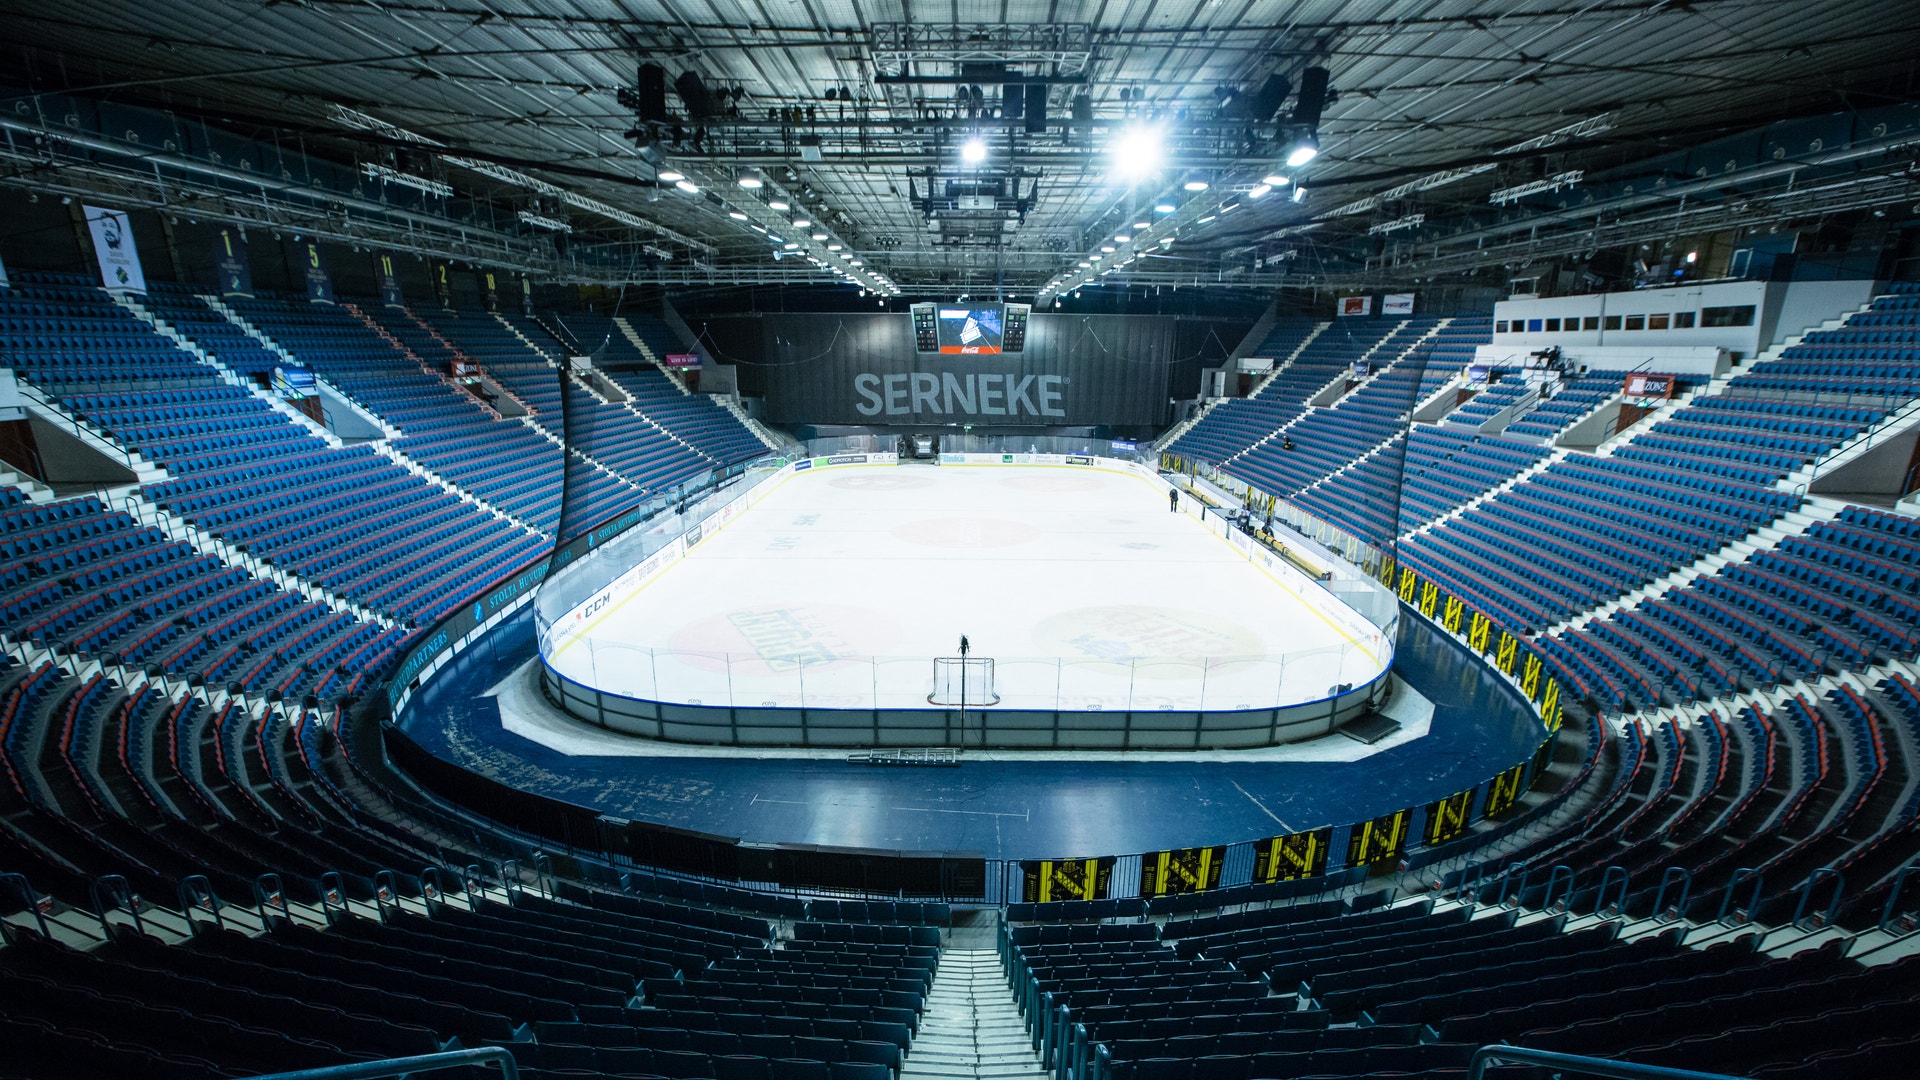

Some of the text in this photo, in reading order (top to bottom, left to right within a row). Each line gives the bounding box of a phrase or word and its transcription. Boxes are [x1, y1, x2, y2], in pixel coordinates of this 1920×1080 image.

[221, 229, 233, 257] 1
[307, 244, 319, 268] 5
[381, 255, 393, 277] 11
[439, 265, 447, 284] 2
[854, 372, 1066, 417] SERNEKE
[1644, 381, 1668, 392] ZONE
[598, 523, 618, 541] STOLTA
[489, 583, 518, 609] STOLTA
[585, 592, 611, 619] CCM
[389, 630, 449, 706] HUVUDPARTNERS
